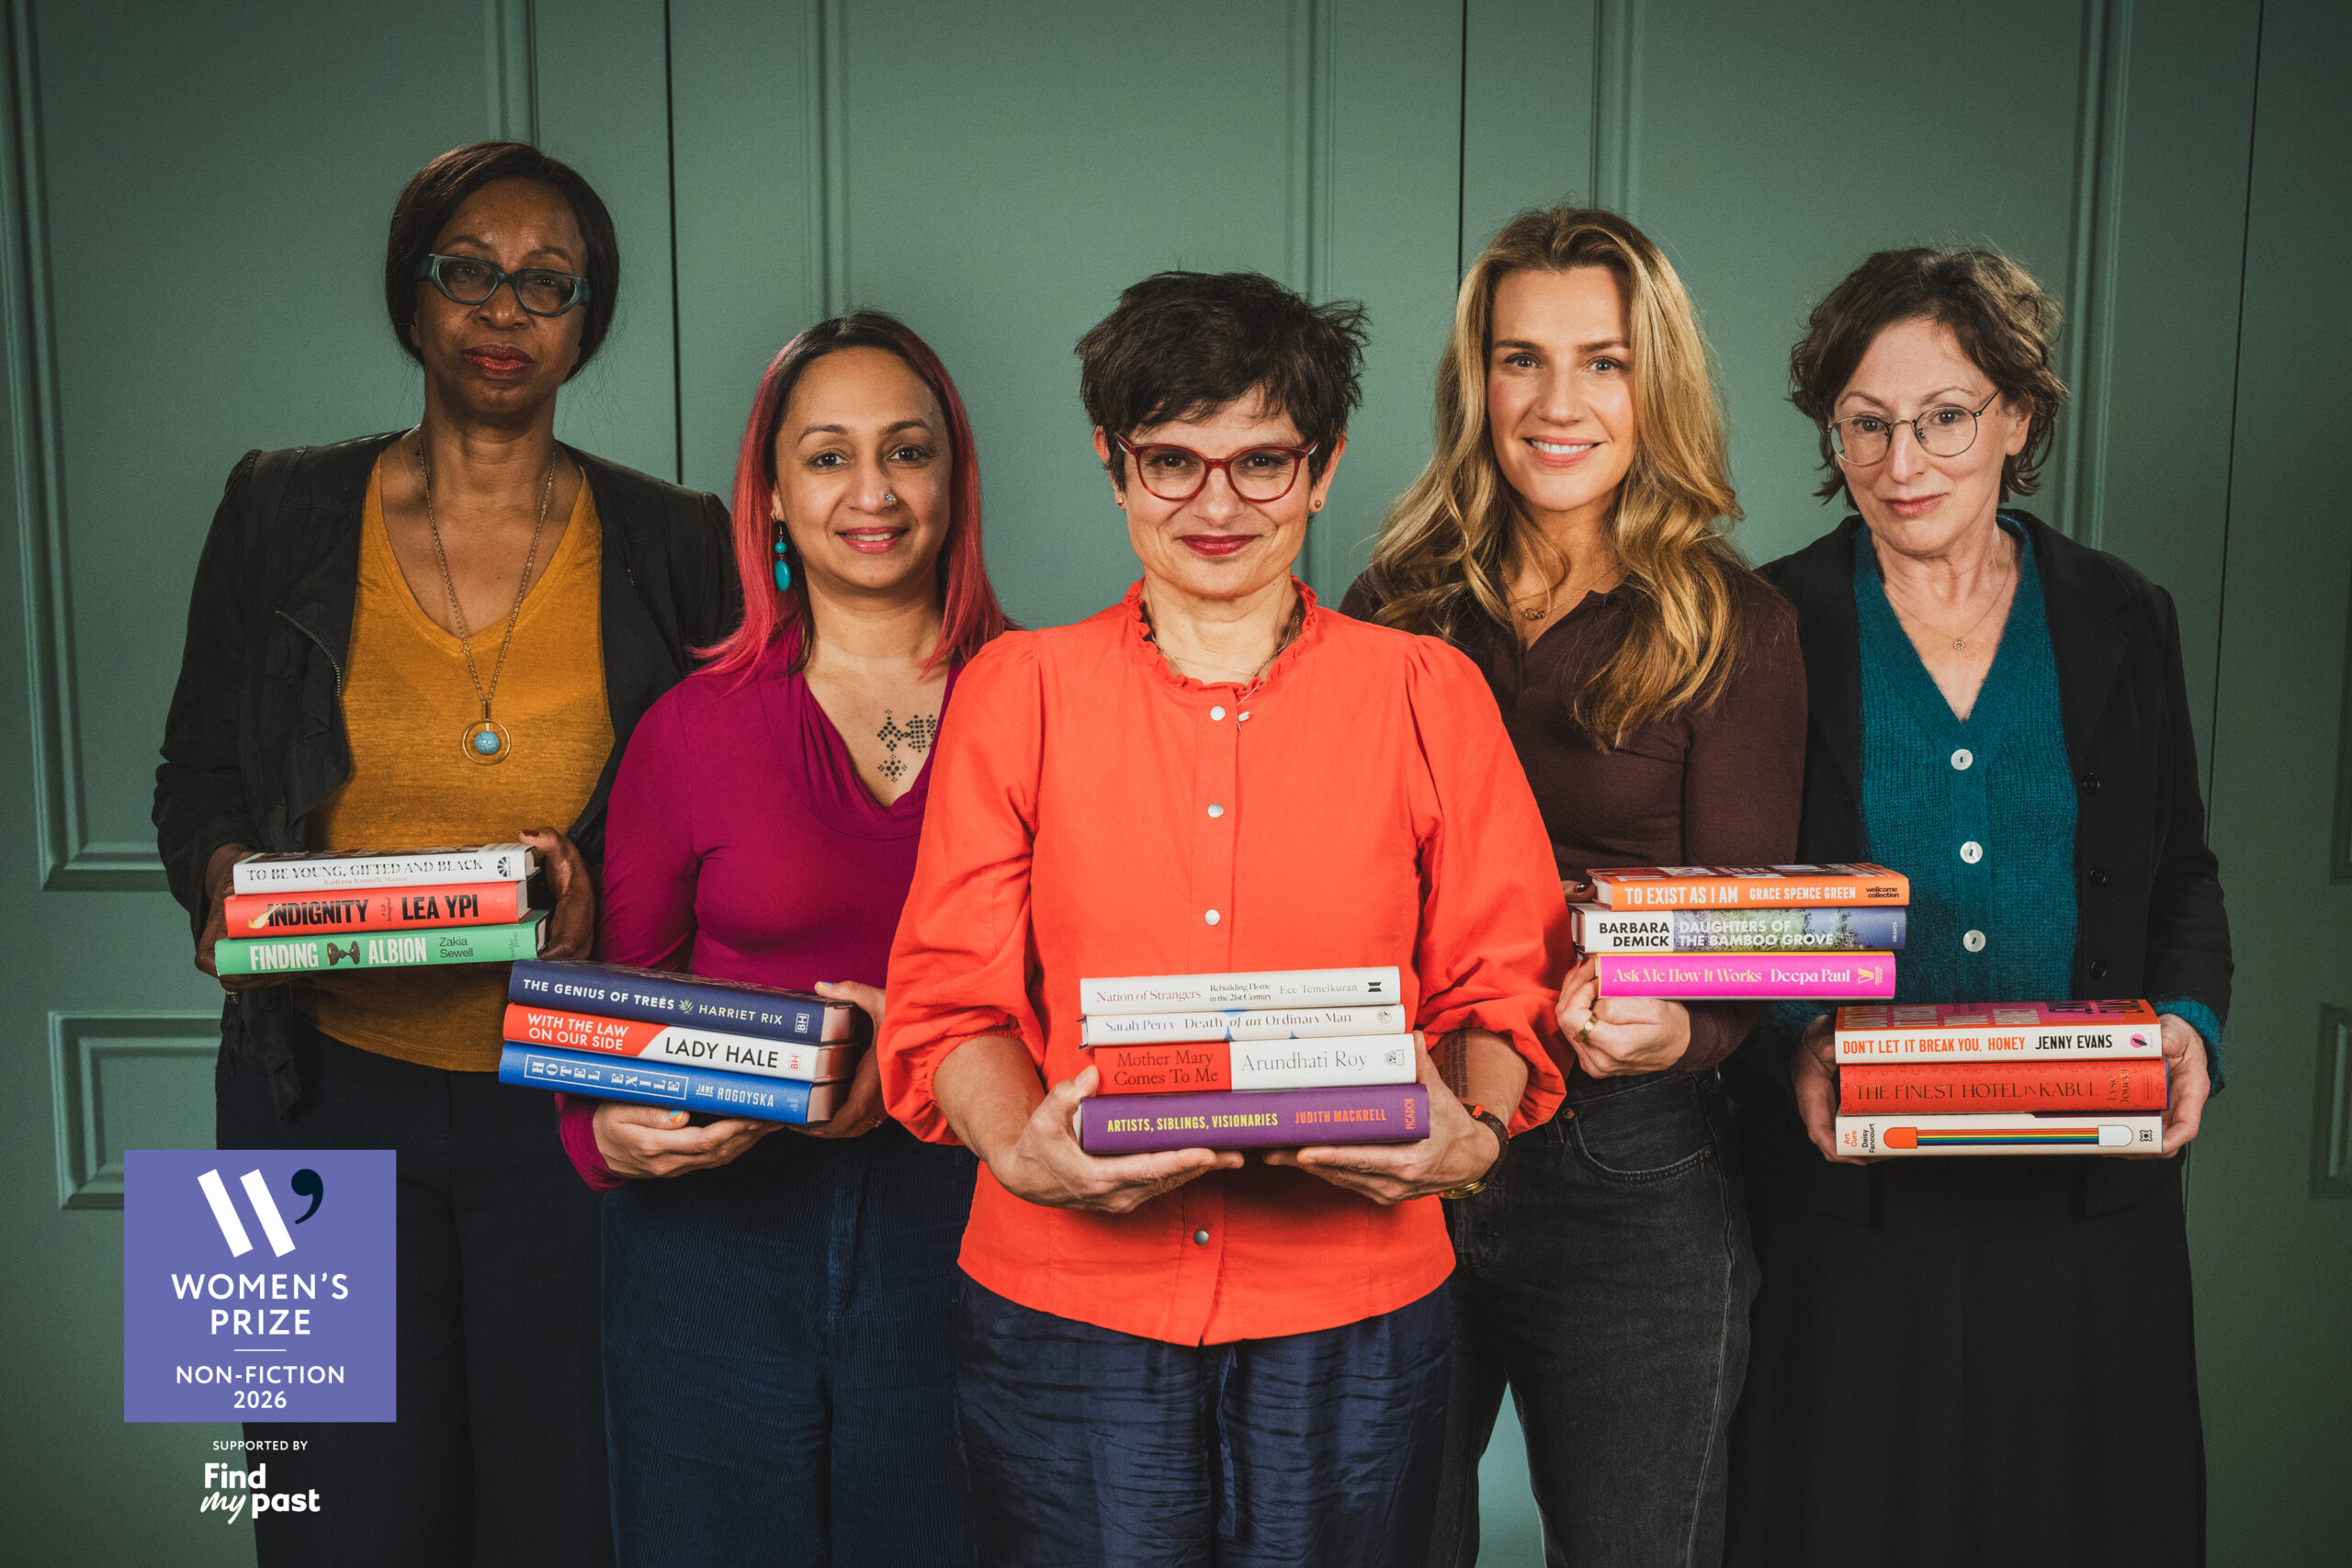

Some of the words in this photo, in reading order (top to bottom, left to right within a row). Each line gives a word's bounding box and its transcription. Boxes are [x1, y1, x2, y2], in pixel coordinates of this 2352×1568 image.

[246, 869, 267, 881] TO
[271, 868, 291, 880] BE
[350, 863, 401, 876] GIFTED
[403, 861, 435, 874] AND
[437, 858, 483, 872] BLACK
[1625, 887, 1644, 905] TO
[1646, 886, 1688, 905] EXIST
[1690, 886, 1707, 904] AS
[1711, 886, 1715, 903] I
[1718, 886, 1738, 903] AM
[1749, 887, 1781, 901] GRACE
[1783, 887, 1822, 900] SPENCE
[1824, 886, 1856, 900] GREEN
[1867, 891, 1900, 899] collection
[267, 898, 368, 927] INDIGNITY
[401, 897, 440, 921] LEA
[446, 895, 479, 919] YPI
[1600, 921, 1670, 935] BARBARA
[1679, 920, 1767, 933] DAUGHTERS
[1774, 920, 1791, 932] OF
[439, 937, 469, 948] Zakia
[1612, 935, 1669, 948] DEMICK
[1679, 934, 1707, 947] THE
[1709, 934, 1778, 946] BAMBOO
[1781, 933, 1834, 946] GROVE
[249, 942, 319, 970] FINDING
[368, 937, 427, 964] ALBION
[440, 948, 474, 959] Sewell
[1612, 968, 1641, 983] Ask
[1643, 969, 1666, 983] Me
[1668, 969, 1702, 983] How
[1703, 969, 1713, 983] It
[1714, 968, 1762, 983] Works
[1770, 968, 1818, 986] Deepa
[1821, 969, 1850, 983] Paul
[524, 979, 548, 993] THE
[554, 983, 605, 999] GENIUS
[610, 991, 629, 1003] OF
[634, 994, 674, 1010] TREES
[1096, 991, 1134, 1002] Nation
[1136, 989, 1148, 1000] of
[1149, 989, 1202, 1002] Strangers
[1210, 984, 1248, 992] Rebuilding
[1301, 984, 1358, 994] Temelkuran
[698, 1004, 756, 1021] HARRIET
[760, 1011, 783, 1025] RIX
[797, 1014, 807, 1031] BH
[1185, 1016, 1223, 1029] Death
[1229, 1016, 1240, 1029] of
[1245, 1017, 1261, 1027] an
[1265, 1013, 1320, 1027] Ordinary
[1325, 1012, 1351, 1023] Man
[527, 1013, 564, 1030] WITH
[568, 1018, 594, 1033] THE
[597, 1021, 628, 1038] LAW
[1105, 1020, 1139, 1032] Sarah
[1143, 1020, 1175, 1032] Perry
[528, 1027, 554, 1042] ON
[557, 1031, 588, 1046] OUR
[592, 1035, 623, 1051] SIDE
[1843, 1041, 1875, 1055] DON'T
[1878, 1040, 1901, 1054] LET
[1905, 1039, 1916, 1054] IT
[1919, 1039, 1955, 1053] BREAK
[1987, 1036, 2025, 1051] HONEY
[2035, 1035, 2072, 1050] JENNY
[2077, 1034, 2112, 1049] EVANS
[665, 1036, 718, 1059] LADY
[726, 1043, 778, 1068] HALE
[1117, 1049, 1170, 1067] Mother
[1175, 1049, 1214, 1067] Mary
[1241, 1050, 1329, 1072] Arundhati
[1335, 1048, 1368, 1071] Roy
[790, 1055, 799, 1070] BH
[532, 1061, 600, 1081] HOTEL
[612, 1073, 680, 1092] EXILE
[1114, 1069, 1165, 1086] Comes
[1172, 1068, 1190, 1084] To
[1195, 1066, 1218, 1083] Me
[695, 1084, 714, 1096] JANE
[718, 1087, 775, 1108] ROGOYSKA
[1857, 1085, 1890, 1100] THE
[1895, 1084, 1956, 1100] FINEST
[1962, 1083, 2022, 1099] HOTEL
[2024, 1085, 2036, 1096] IN
[2039, 1082, 2099, 1097] KABUL
[2107, 1075, 2118, 1100] Lyse
[1107, 1118, 1154, 1133] ARTISTS,
[1157, 1116, 1209, 1131] SIBLINGS,
[1212, 1113, 1278, 1128] VISIONARIES
[1295, 1111, 1330, 1124] JUDITH
[1333, 1109, 1386, 1122] MACKRELL
[1405, 1098, 1415, 1130] PICADOR
